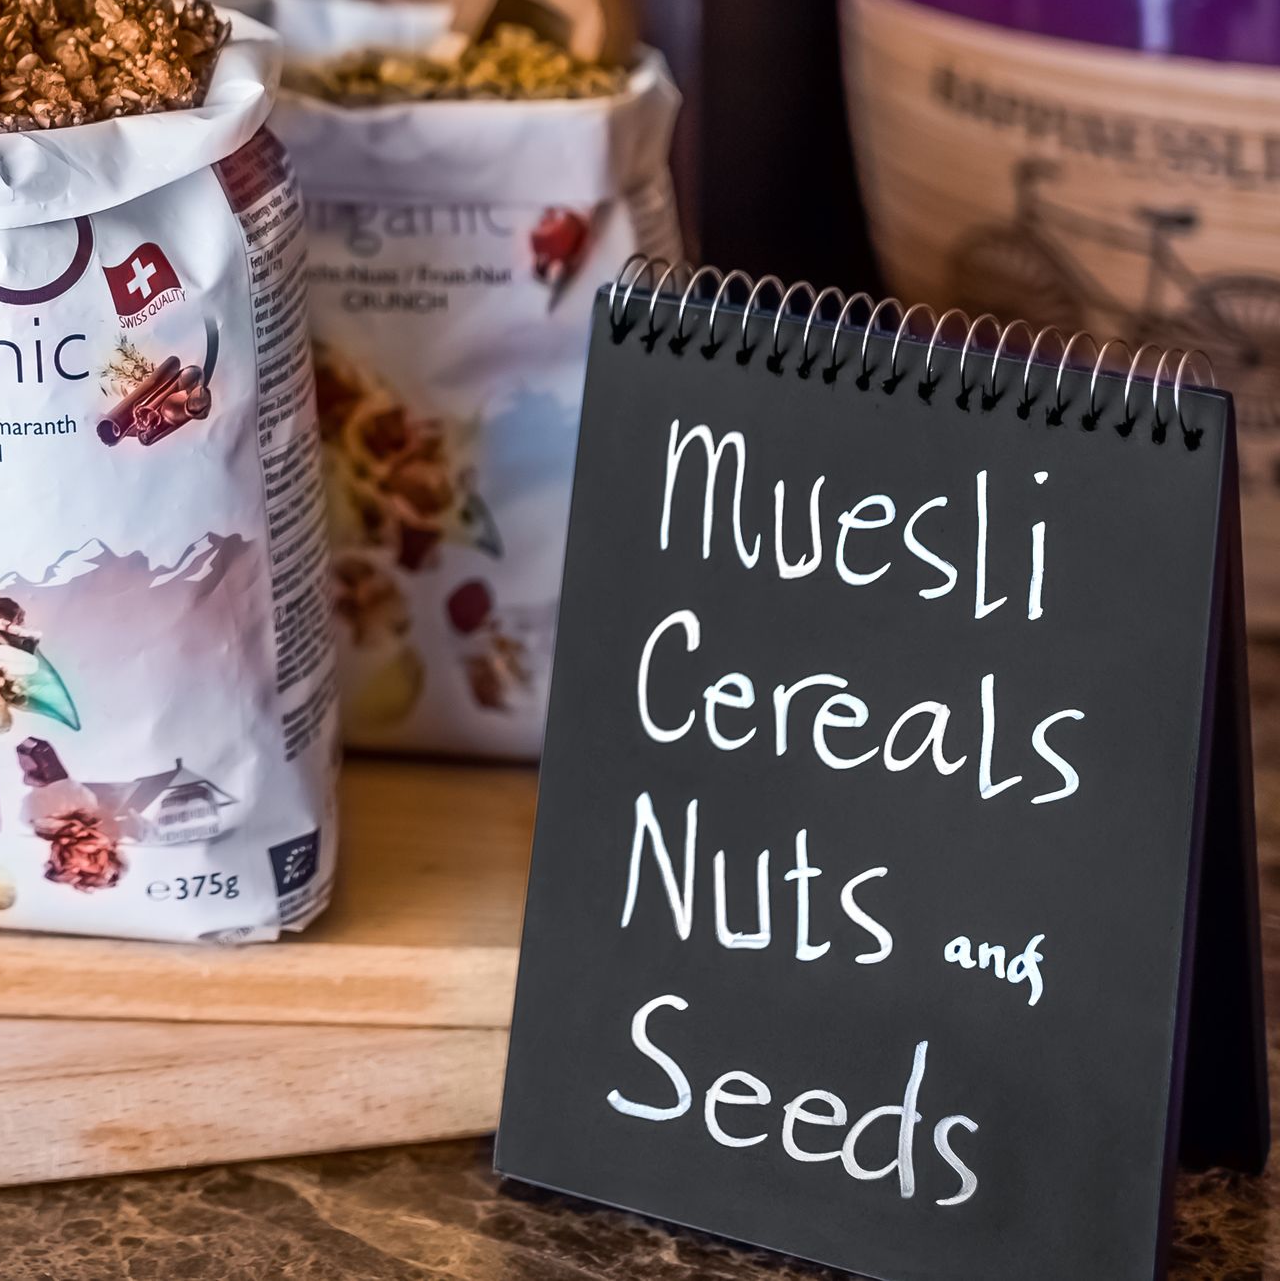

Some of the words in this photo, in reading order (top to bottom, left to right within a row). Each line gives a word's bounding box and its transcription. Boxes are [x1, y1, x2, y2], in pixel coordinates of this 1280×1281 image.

[119, 310, 148, 329] SWISS
[148, 289, 186, 316] QUALITY
[305, 201, 513, 259] rganic
[637, 609, 1088, 805] Cereals
[619, 791, 895, 965] Nuts
[942, 932, 1046, 1007] and
[605, 993, 980, 1206] Seeds
